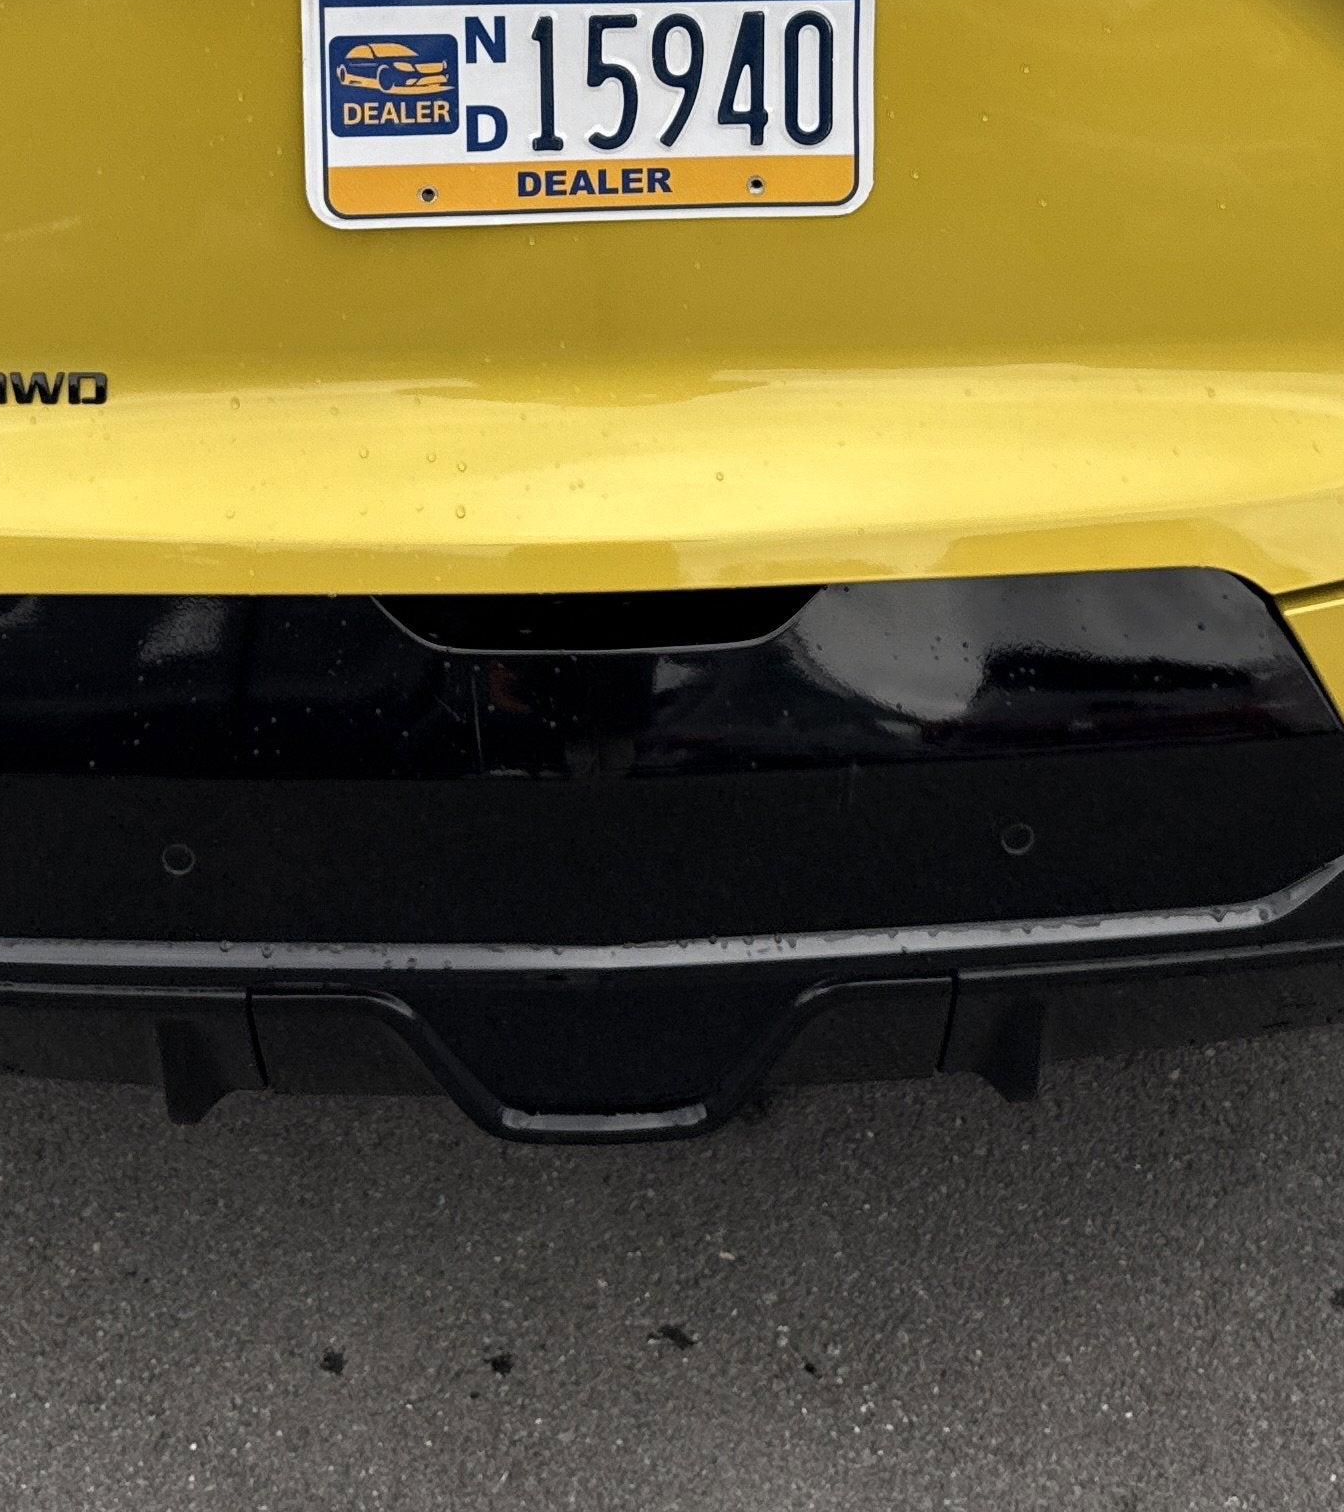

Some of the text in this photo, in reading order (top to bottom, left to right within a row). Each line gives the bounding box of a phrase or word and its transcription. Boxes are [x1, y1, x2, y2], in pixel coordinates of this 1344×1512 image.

[530, 10, 833, 151] 15940
[343, 102, 450, 125] DEALER
[517, 169, 672, 197] DEALER
